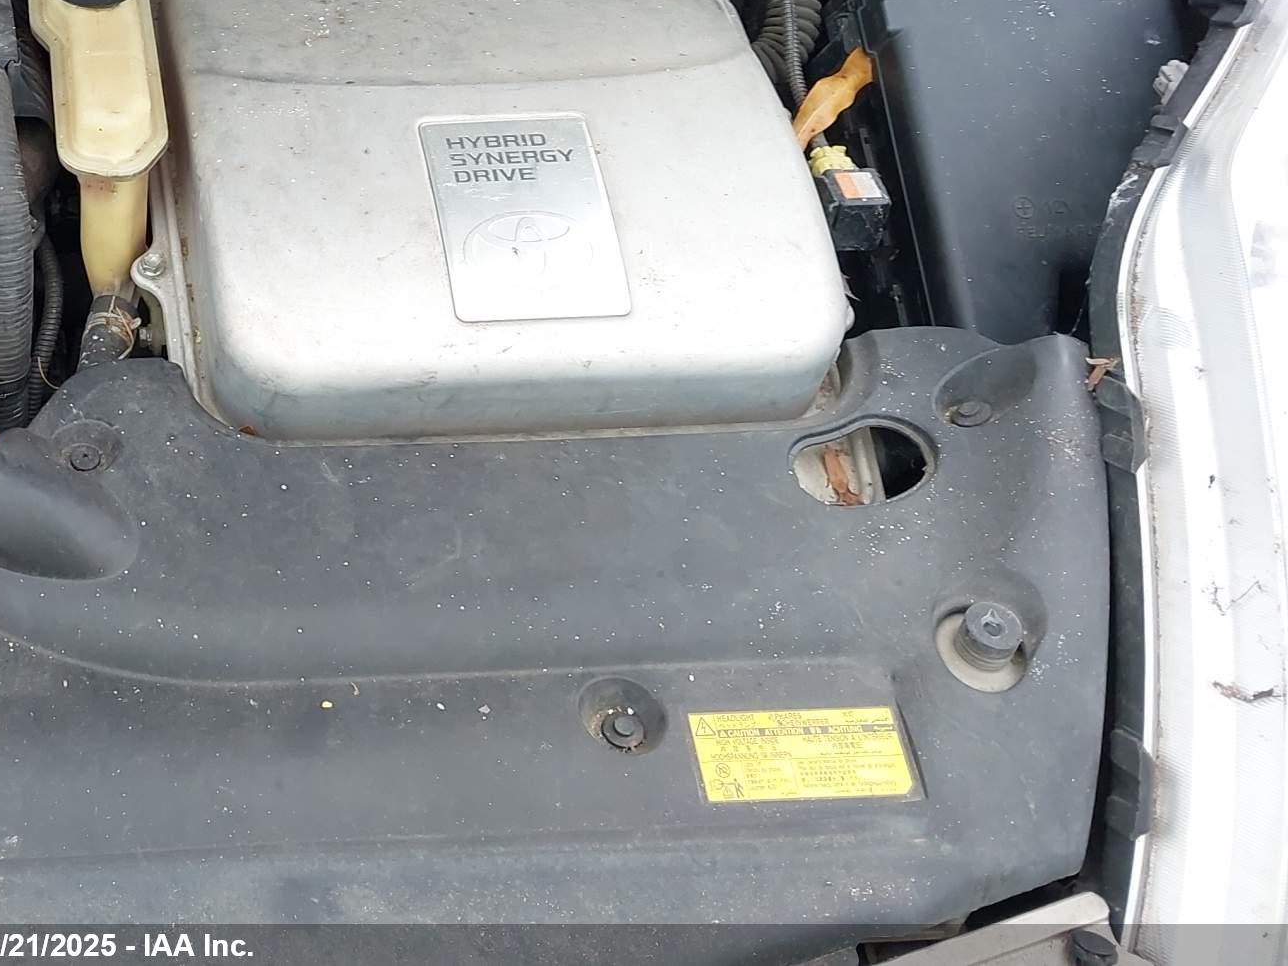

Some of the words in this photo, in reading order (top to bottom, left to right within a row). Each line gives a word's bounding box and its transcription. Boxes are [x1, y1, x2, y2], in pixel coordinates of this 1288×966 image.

[445, 133, 547, 150] HYBRID
[448, 148, 574, 167] SYNERGY
[453, 167, 537, 184] DRIVE
[727, 729, 760, 737] CAUTION
[765, 727, 804, 736] ATTENTION
